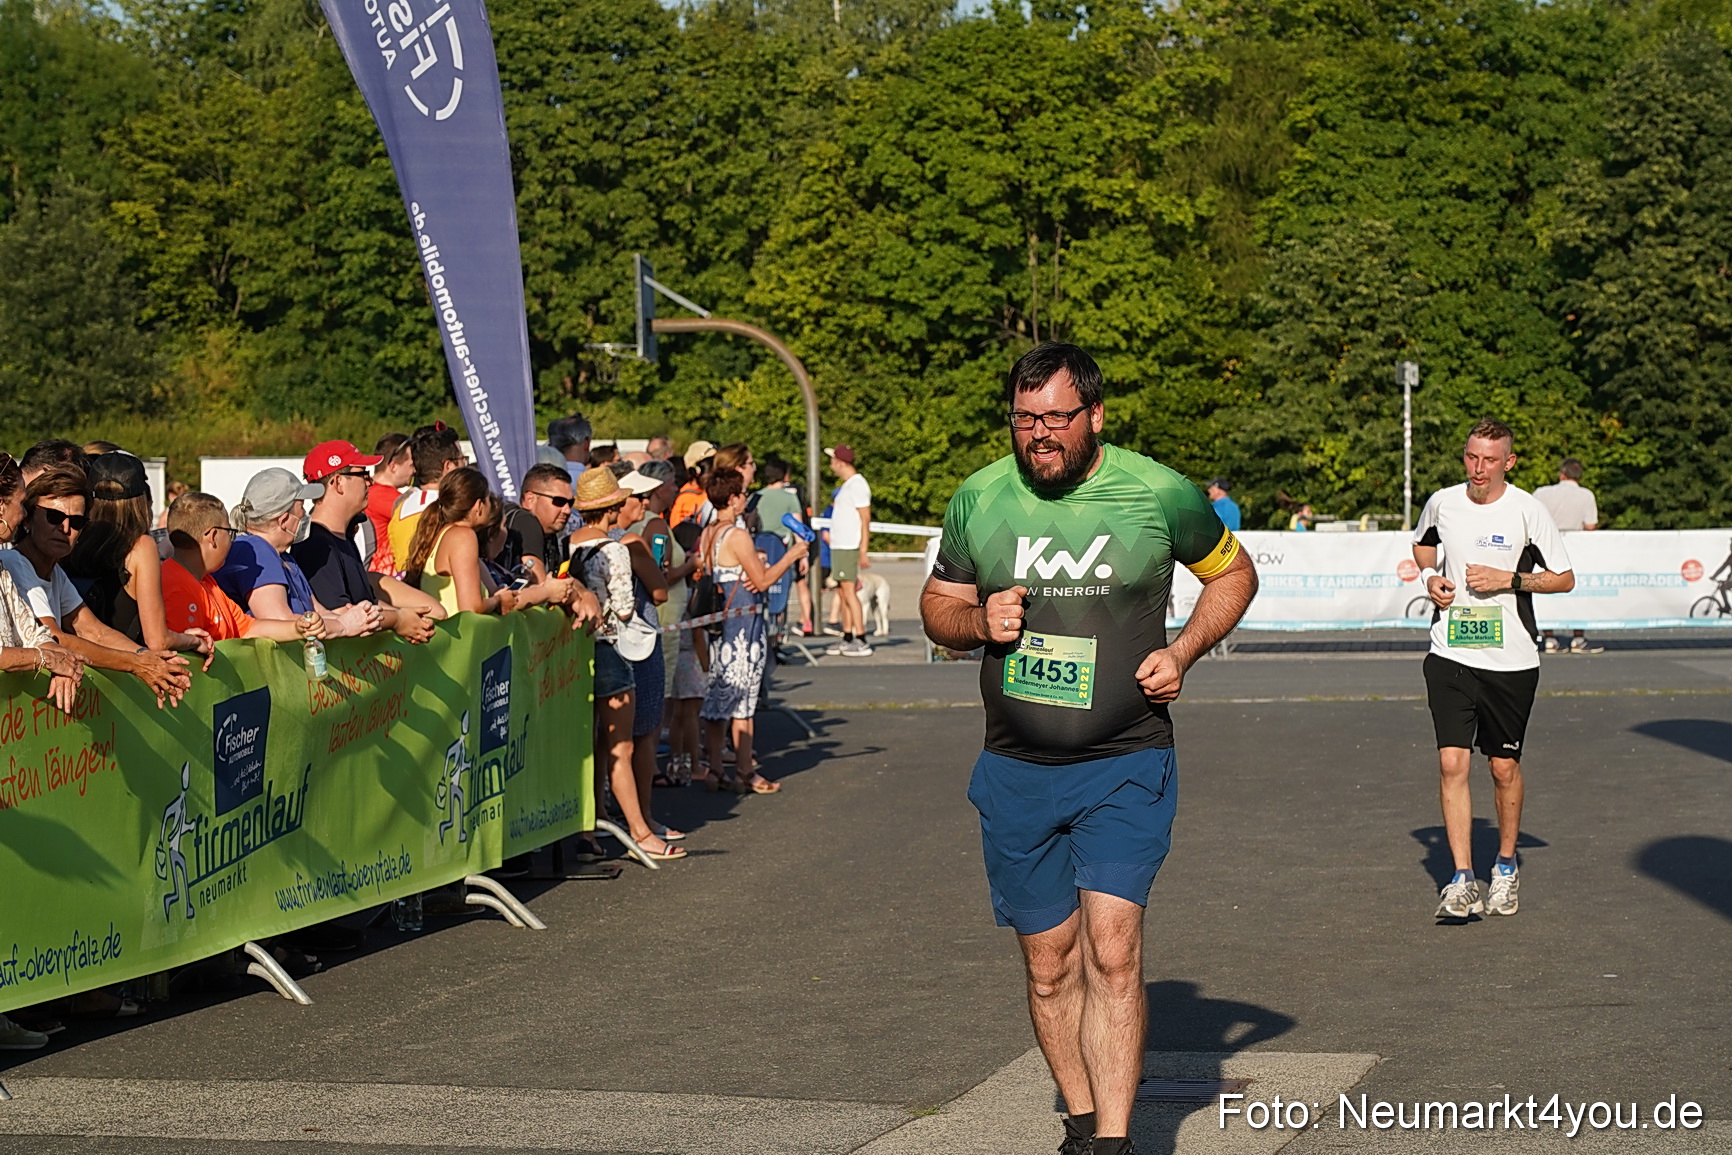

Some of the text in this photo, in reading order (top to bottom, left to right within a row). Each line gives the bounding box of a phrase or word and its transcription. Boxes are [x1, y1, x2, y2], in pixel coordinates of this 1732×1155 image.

[1043, 585, 1111, 597] ENERGIE
[1306, 576, 1317, 588] &
[1460, 620, 1489, 635] 538
[1007, 659, 1017, 684] RUN
[1014, 676, 1080, 693] Niedermeyer Johannes
[1018, 655, 1078, 685] 1453
[1079, 666, 1090, 699] 2022
[225, 726, 260, 755] Fischer
[45, 721, 116, 797] länger!
[194, 763, 312, 879] firmenlauf
[200, 861, 247, 909] neumarkt
